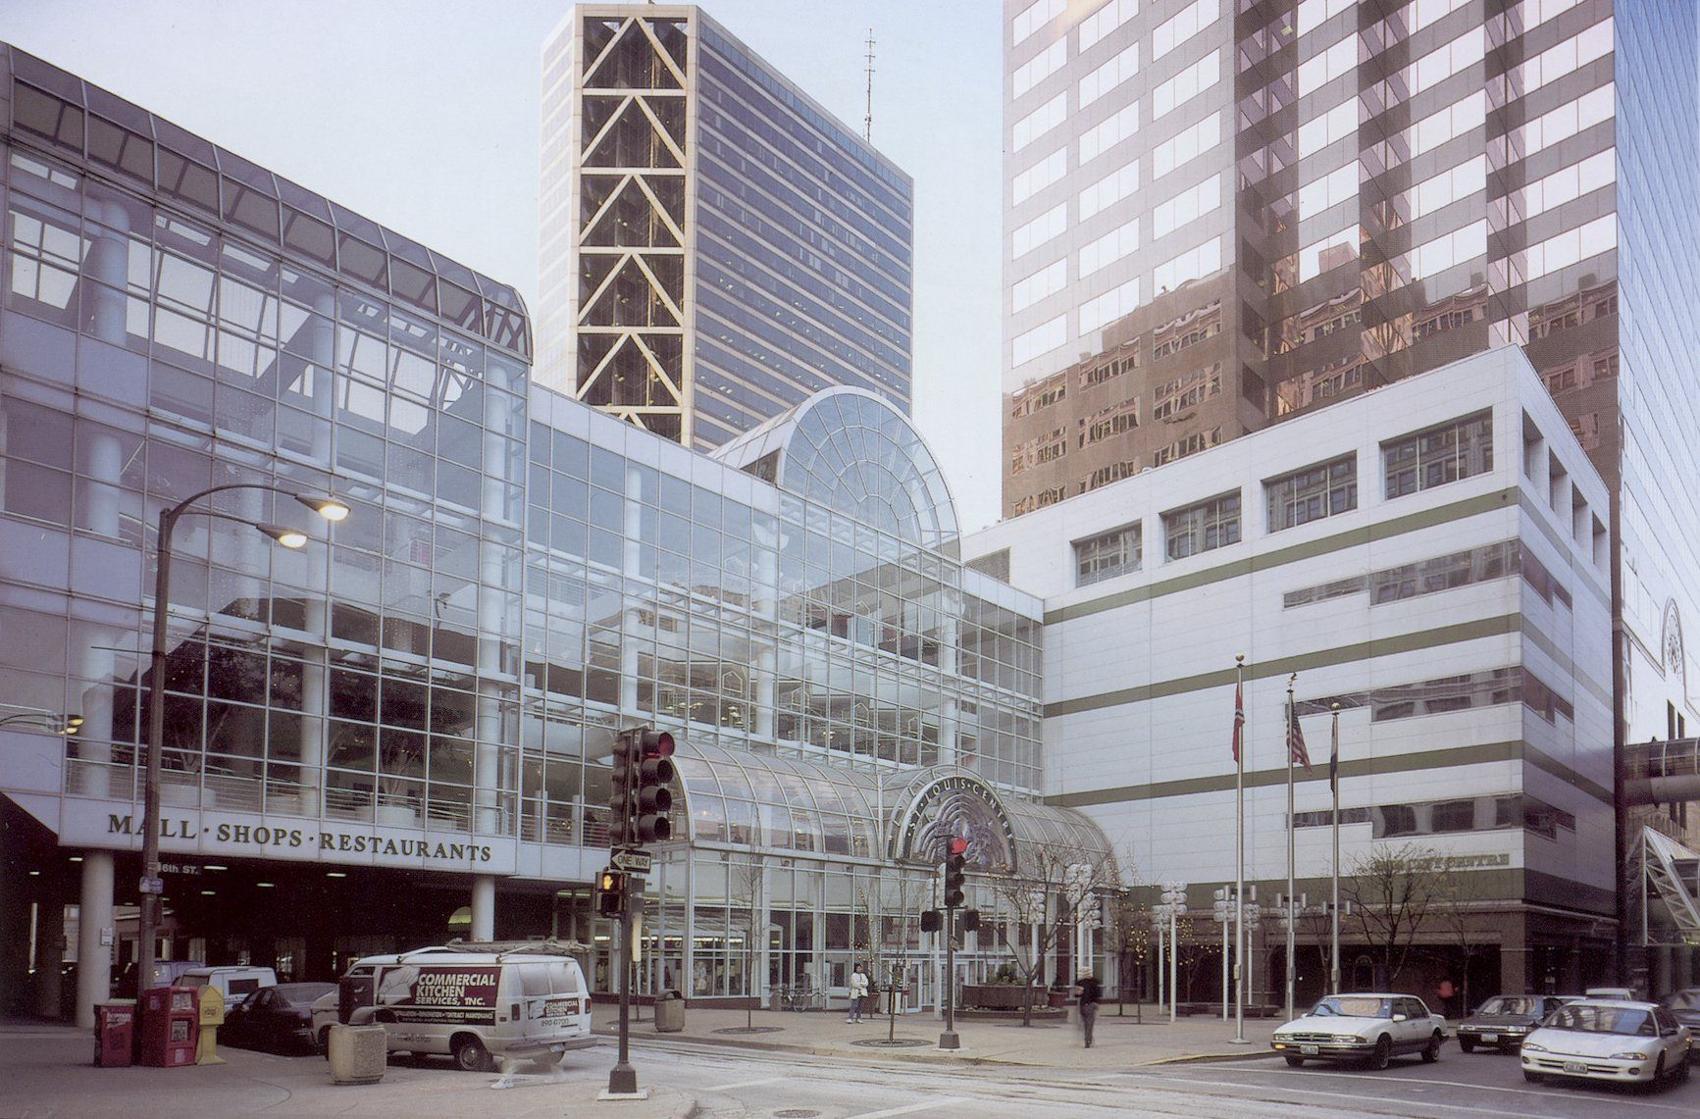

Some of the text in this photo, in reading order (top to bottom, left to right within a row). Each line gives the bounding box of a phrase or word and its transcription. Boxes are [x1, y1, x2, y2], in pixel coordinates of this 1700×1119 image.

[924, 778, 967, 803] LOUIS
[217, 823, 302, 848] SHOPS
[319, 832, 492, 862] RESTAURANTS
[617, 854, 649, 867] ONE WAY
[182, 865, 199, 875] ST.
[418, 974, 496, 987] COMMERCIAL
[415, 985, 465, 998] KITCHEN
[415, 996, 486, 1006] SERVICES, INC.
